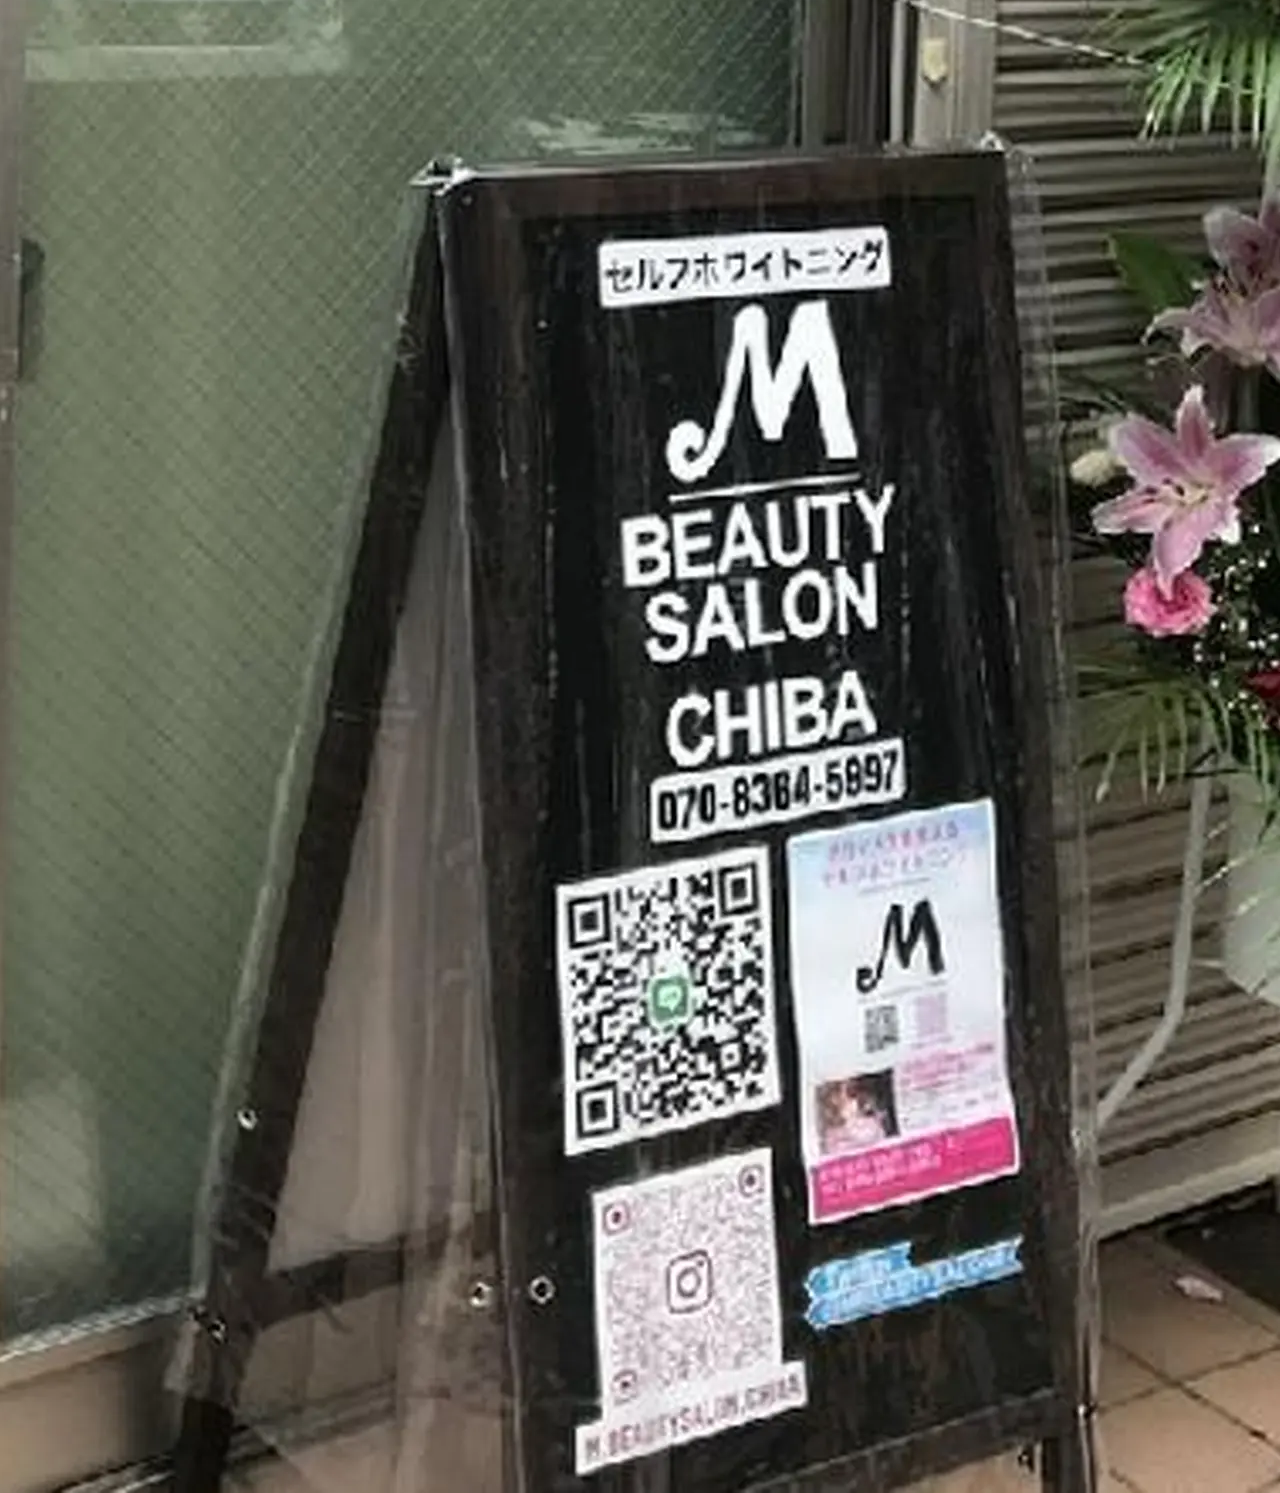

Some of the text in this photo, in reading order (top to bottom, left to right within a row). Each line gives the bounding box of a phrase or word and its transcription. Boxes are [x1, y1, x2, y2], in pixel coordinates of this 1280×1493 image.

[605, 239, 886, 294] セルフホワイトニング
[666, 299, 858, 483] M
[621, 485, 895, 588] BEAUTY
[644, 562, 877, 663] SALON
[666, 670, 877, 768] CHIBA
[856, 899, 946, 994] M
